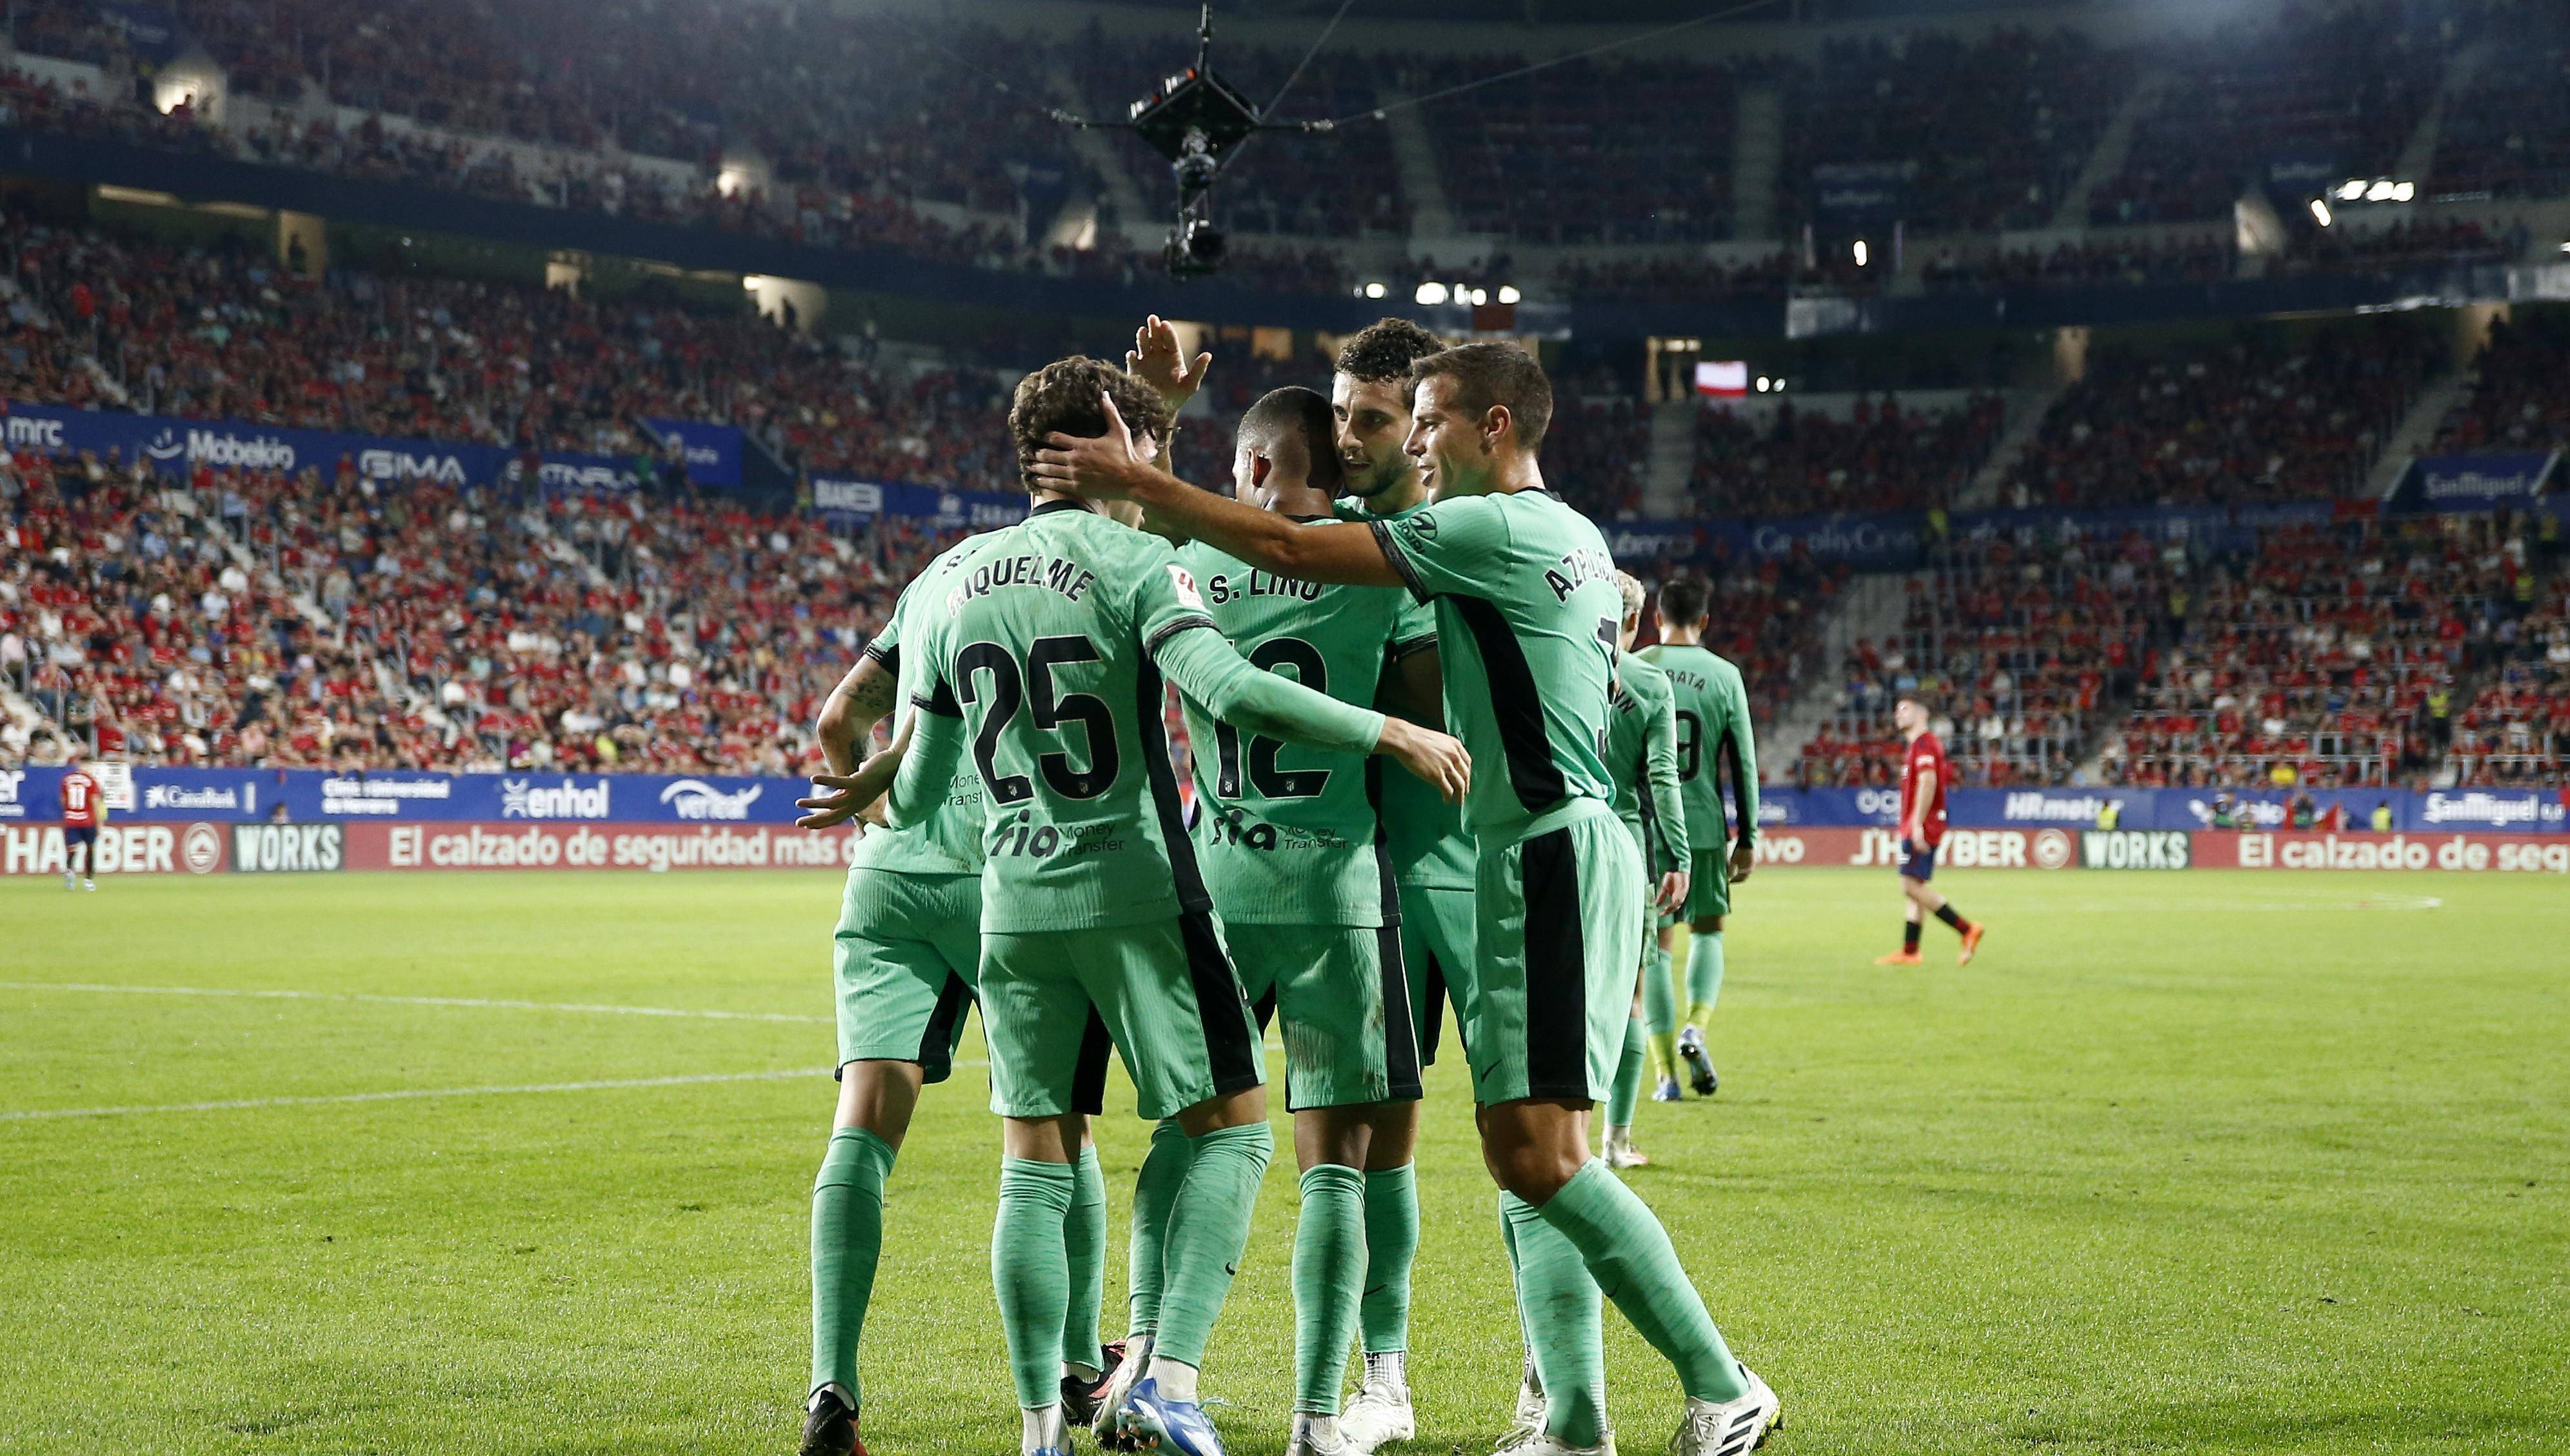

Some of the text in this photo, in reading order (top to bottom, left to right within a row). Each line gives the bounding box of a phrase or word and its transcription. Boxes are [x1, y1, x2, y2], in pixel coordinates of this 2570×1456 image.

[1209, 573, 1240, 604] S.
[1666, 668, 1706, 692] RATA
[955, 634, 1120, 806] 25
[68, 786, 85, 810] 11
[528, 779, 610, 818] enhol
[949, 774, 980, 789] Mone
[235, 824, 341, 872] WORKS
[390, 826, 423, 866] El
[430, 826, 559, 866] calzado
[566, 826, 608, 866] de
[613, 824, 768, 872] seguridad
[775, 828, 837, 866] más
[989, 809, 1060, 858] ria
[2082, 830, 2189, 870] WORKS
[2238, 833, 2274, 868] El
[2282, 833, 2431, 870] calzado
[2438, 834, 2490, 870] de
